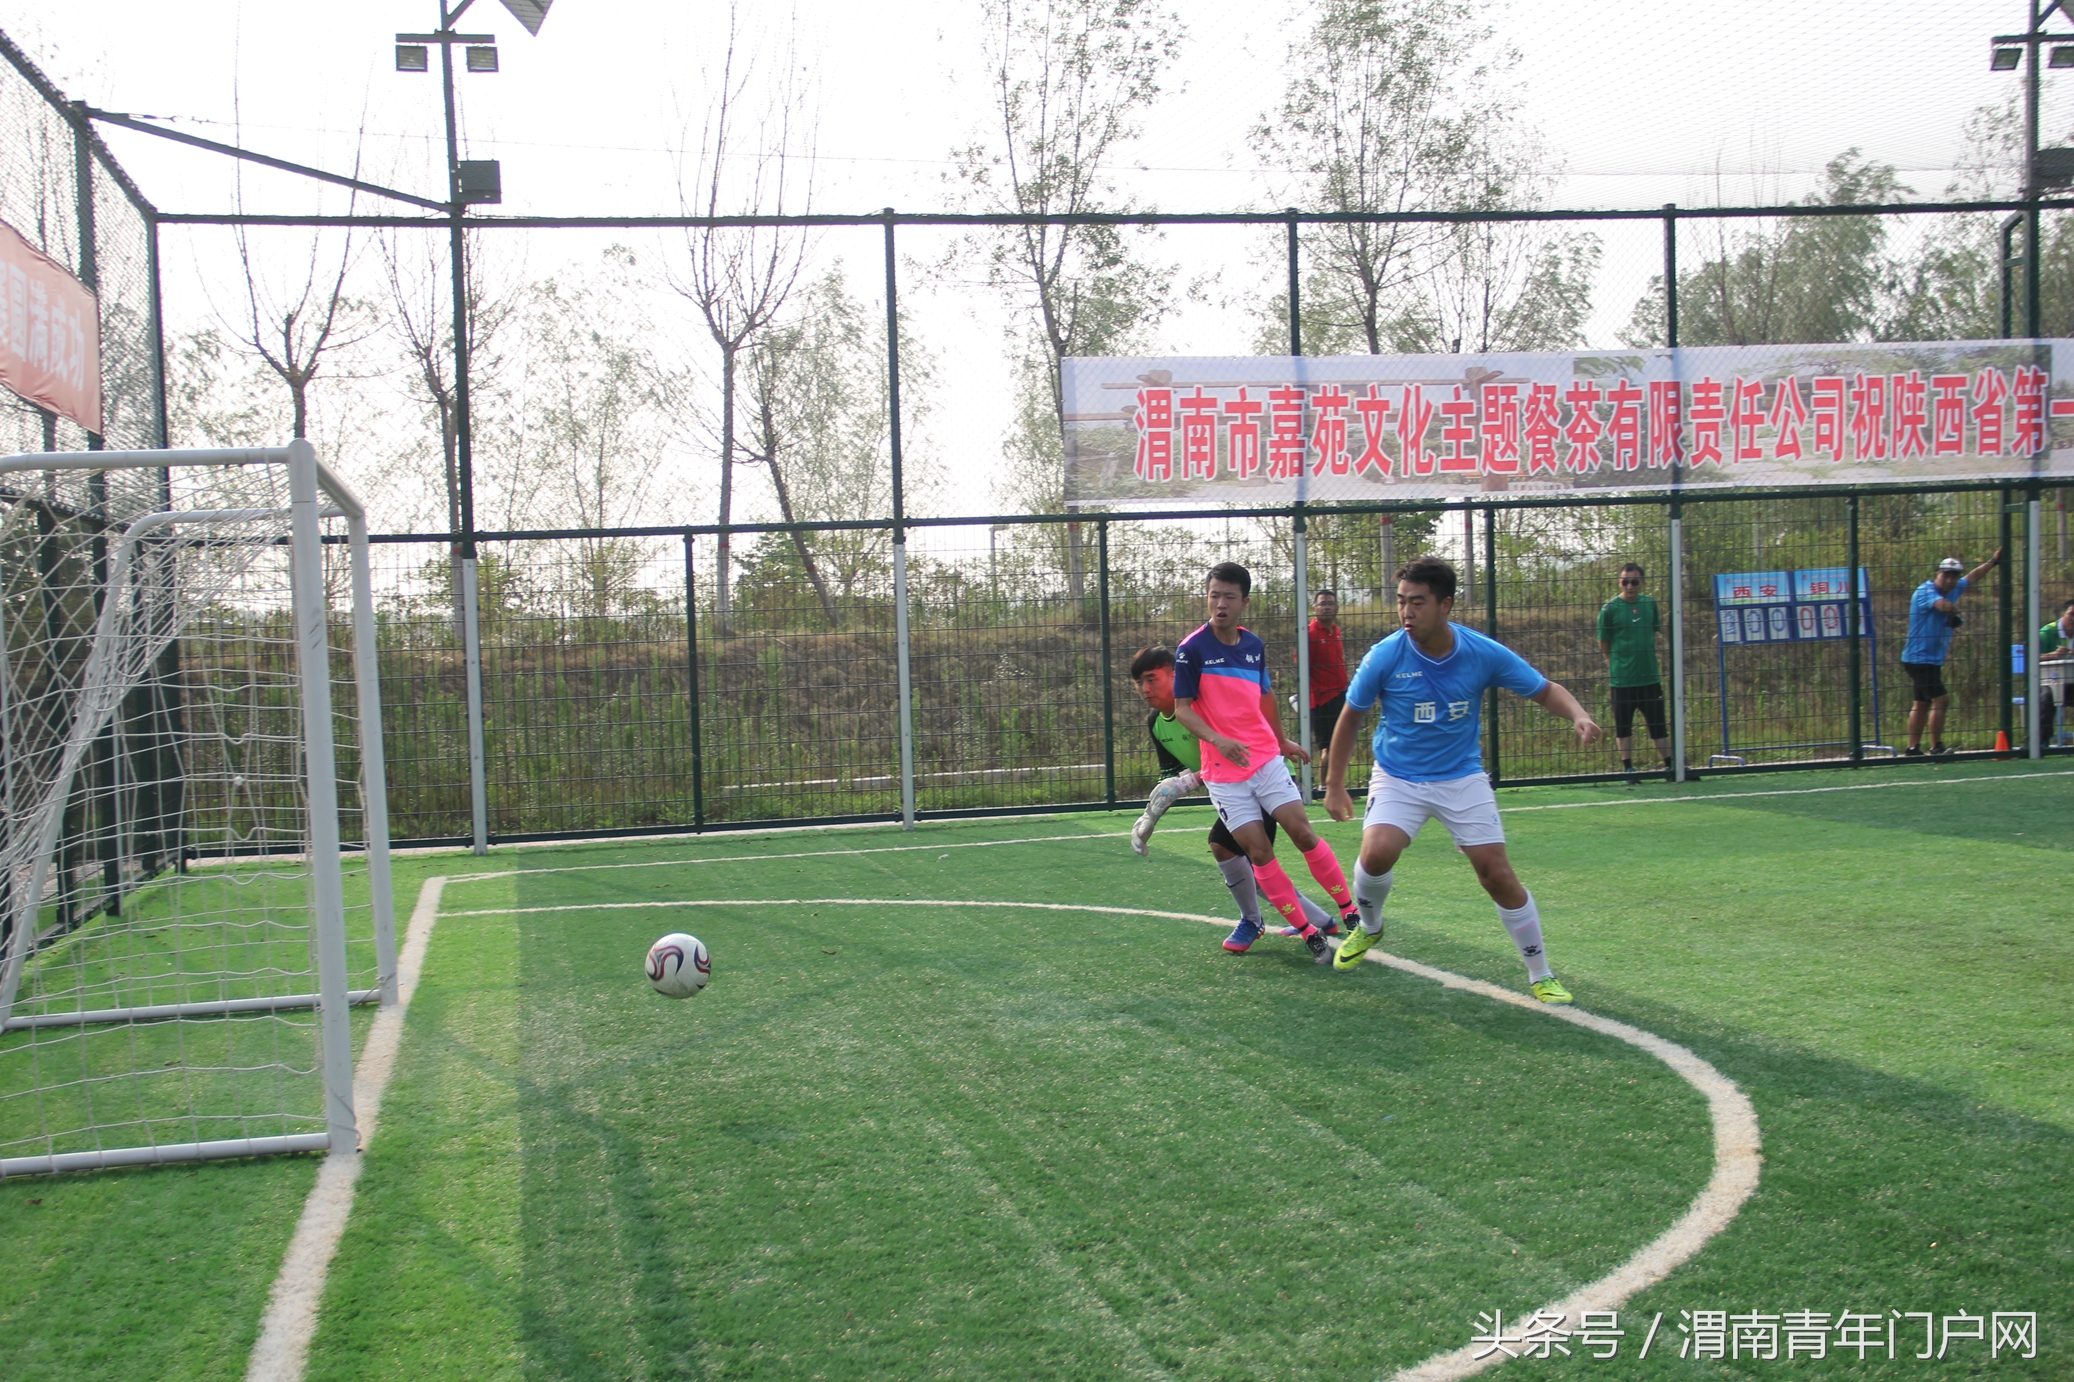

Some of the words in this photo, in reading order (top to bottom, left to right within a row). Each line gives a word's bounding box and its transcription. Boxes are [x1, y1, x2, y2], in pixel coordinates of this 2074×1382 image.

[1732, 585, 1778, 598] 西安
[1204, 657, 1225, 665] KELME
[1395, 671, 1423, 679] KELME
[1414, 701, 1469, 724] 西安
